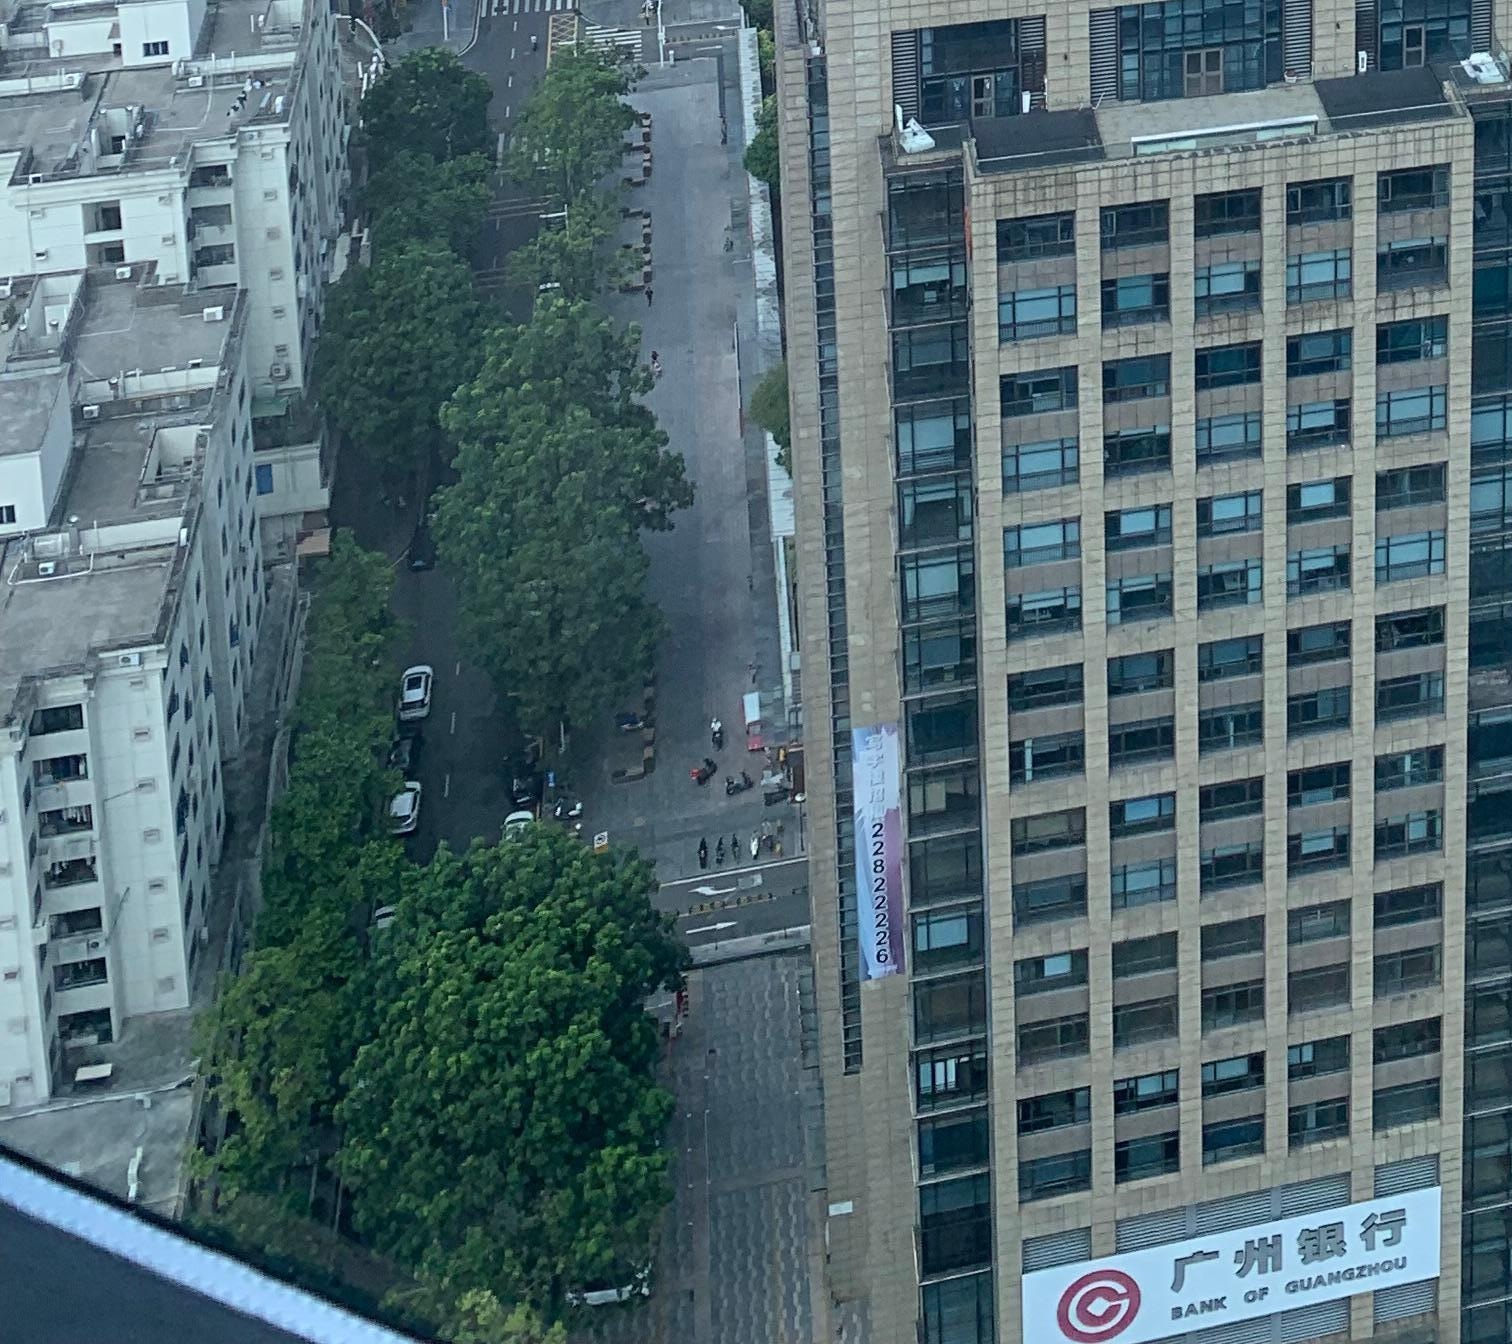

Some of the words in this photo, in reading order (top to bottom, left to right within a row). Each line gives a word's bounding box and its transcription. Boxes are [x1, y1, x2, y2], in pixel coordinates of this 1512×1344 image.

[871, 823, 889, 964] 22822226
[1170, 1208, 1407, 1294] 广州银行
[1171, 1296, 1227, 1321] BANK
[1244, 1286, 1269, 1304] OF
[1285, 1256, 1407, 1295] GUANGZHOU
